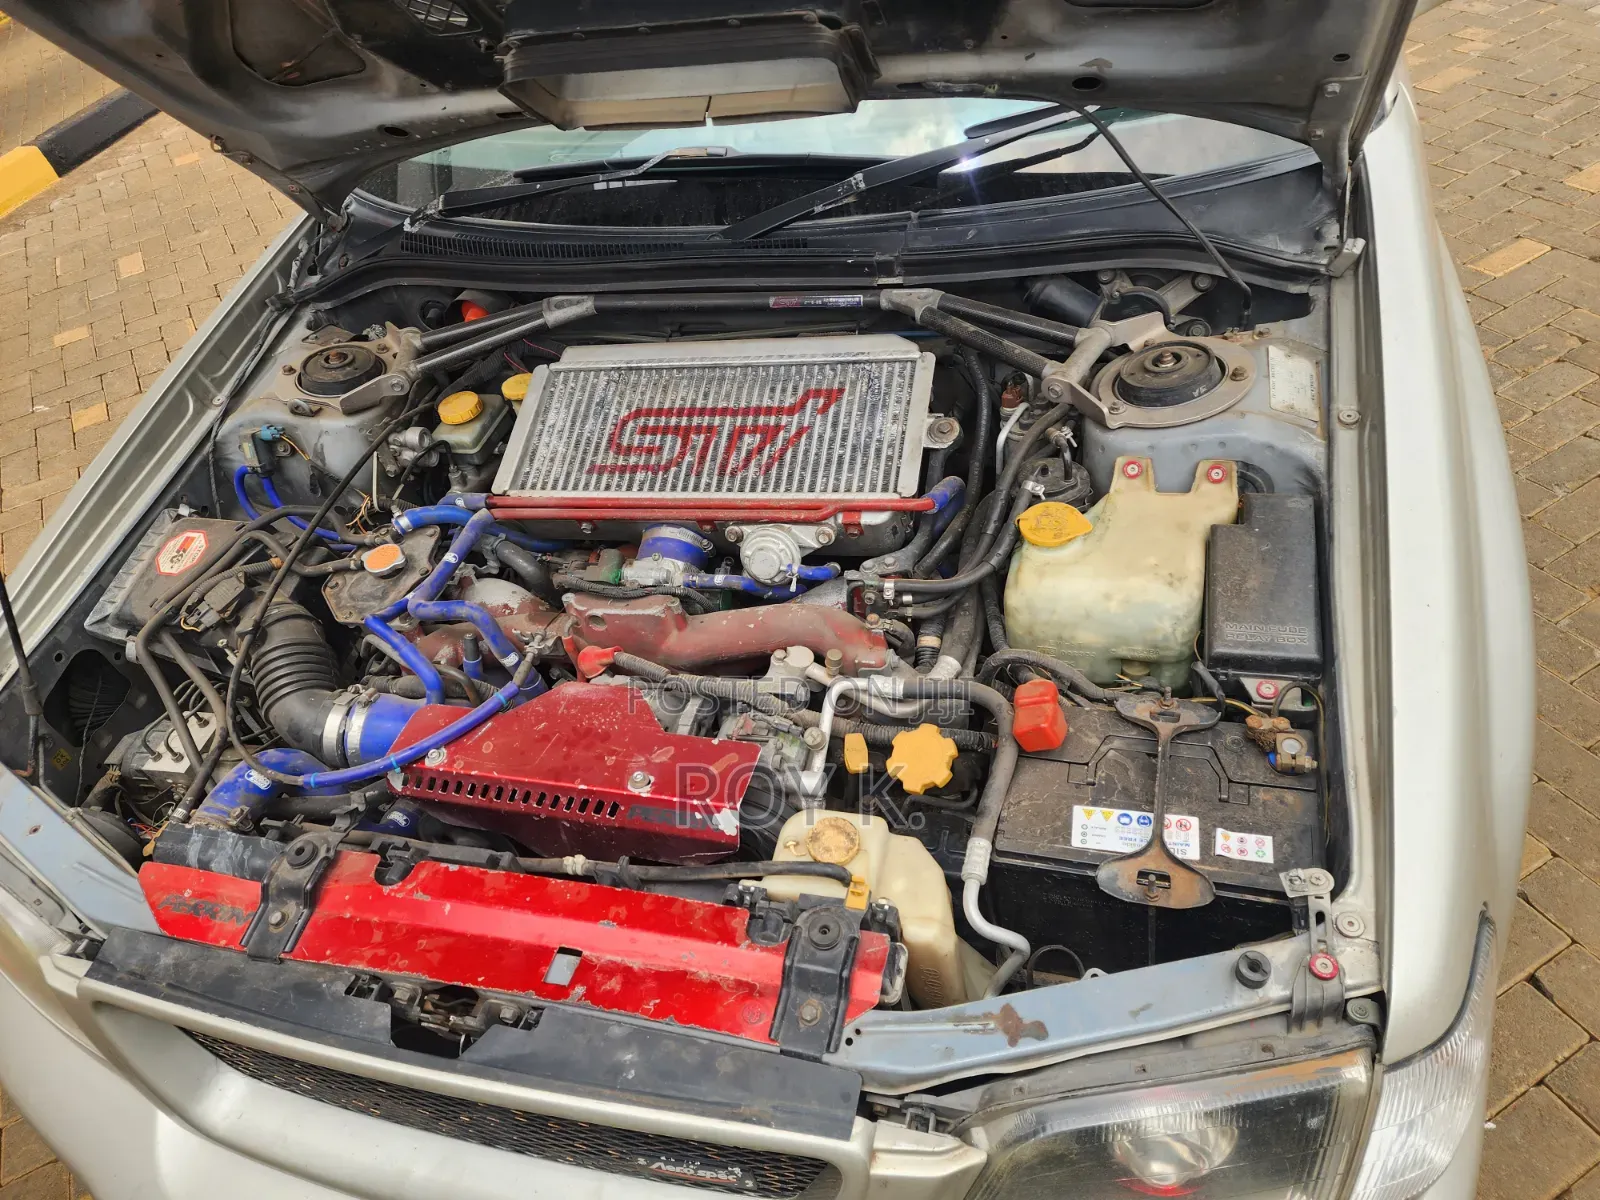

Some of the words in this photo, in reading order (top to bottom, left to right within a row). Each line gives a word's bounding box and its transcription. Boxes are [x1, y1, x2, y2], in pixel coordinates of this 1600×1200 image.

[1225, 622, 1265, 632] MAIN
[1226, 633, 1273, 642] RELAY
[1276, 636, 1309, 645] BOX
